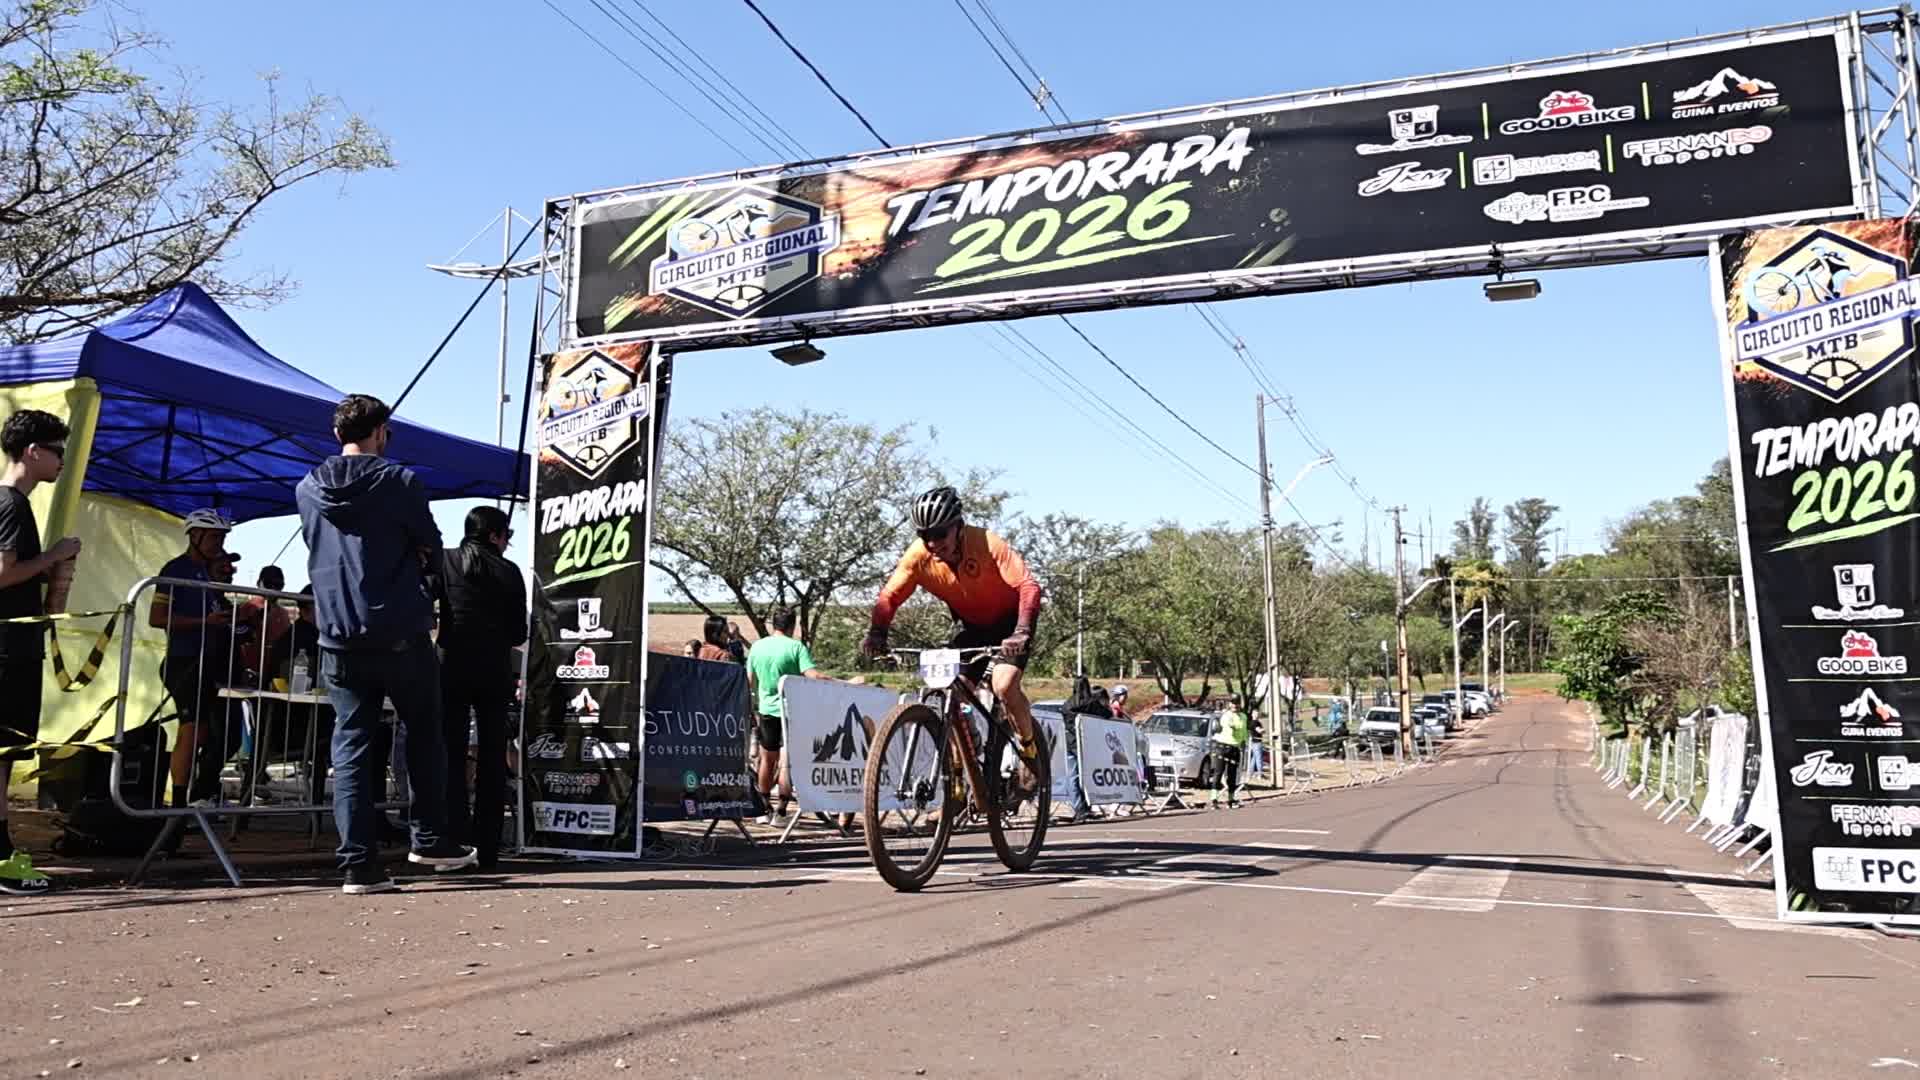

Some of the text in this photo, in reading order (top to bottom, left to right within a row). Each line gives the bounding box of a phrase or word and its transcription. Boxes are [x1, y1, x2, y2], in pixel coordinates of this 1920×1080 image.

[1502, 107, 1634, 133] GOOD BIKE
[1672, 96, 1779, 119] GUINA EVENTOS
[1624, 126, 1770, 157] FERNANDO
[887, 126, 1252, 237] TEMPORADA
[934, 180, 1193, 279] 2026
[659, 225, 829, 284] CIRCUITO REGIONAL
[716, 263, 769, 288] MTB
[1742, 286, 1917, 352] CIRCUITO REGIONAL
[1806, 332, 1859, 360] MTB
[544, 412, 590, 441] CIRCUITO
[576, 427, 608, 447] MTB
[1787, 449, 1916, 533] 2026
[554, 515, 631, 575] 2026
[1819, 658, 1906, 672] GOOD BIKE
[1841, 727, 1903, 737] GUINA EVENTOS
[648, 744, 712, 756] CONFORTO
[811, 767, 849, 786] GUINA
[1092, 767, 1129, 787] GOOD
[1794, 751, 1852, 784] JKM
[552, 809, 591, 829] FPC
[21, 879, 49, 888] FILA
[1860, 858, 1917, 884] FPC
